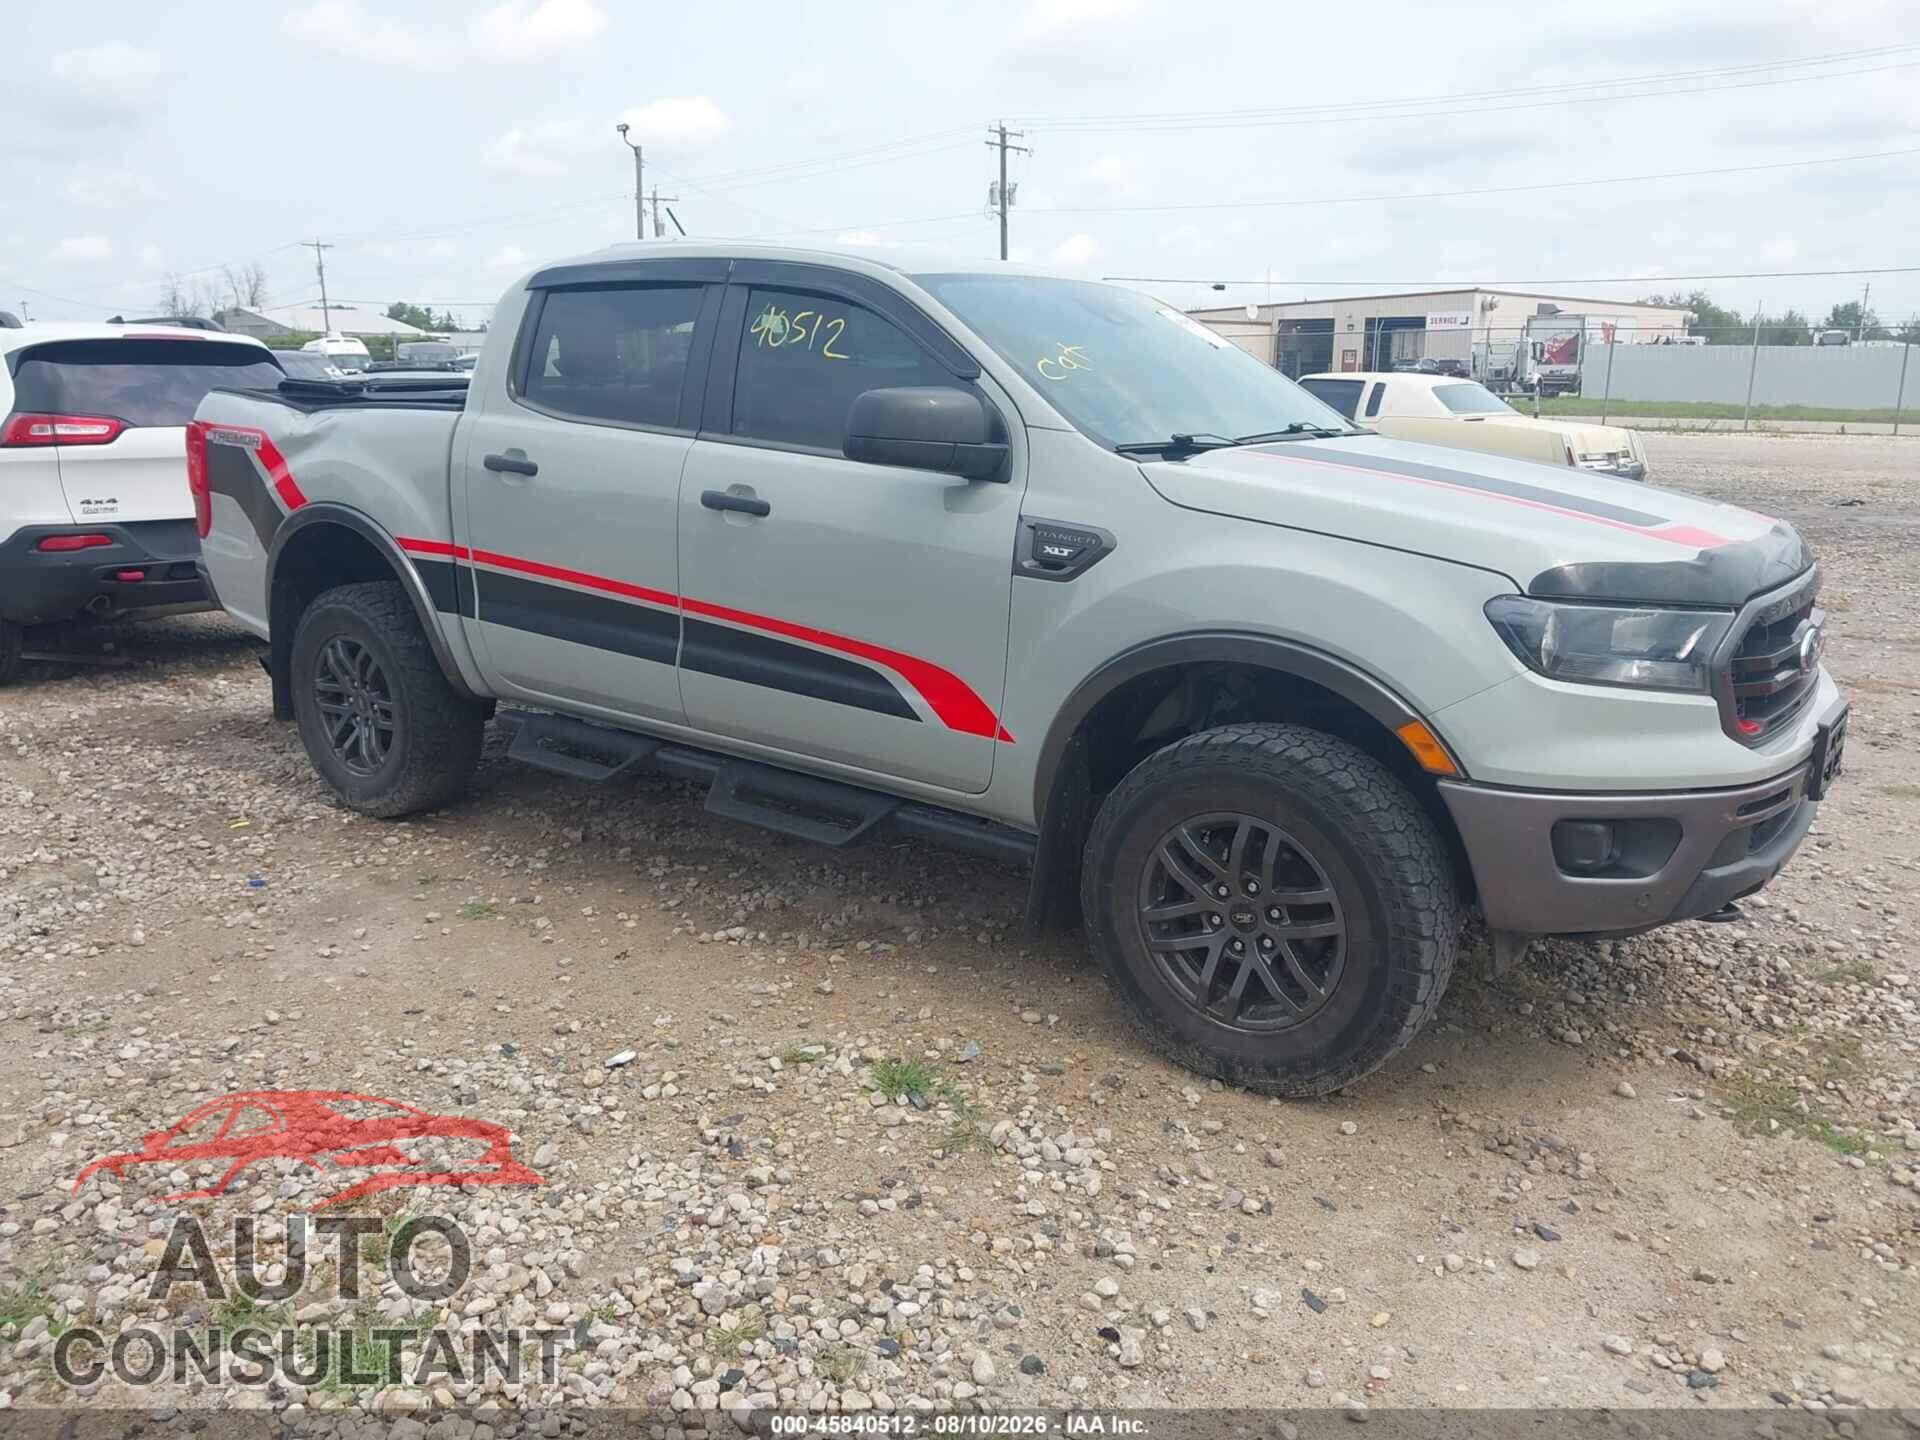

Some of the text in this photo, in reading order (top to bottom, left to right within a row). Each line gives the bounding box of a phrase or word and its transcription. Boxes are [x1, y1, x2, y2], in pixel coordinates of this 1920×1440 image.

[1429, 316, 1457, 325] SERVICE
[750, 303, 850, 360] 40512
[1037, 531, 1097, 545] RANGER
[1042, 545, 1074, 557] XLT
